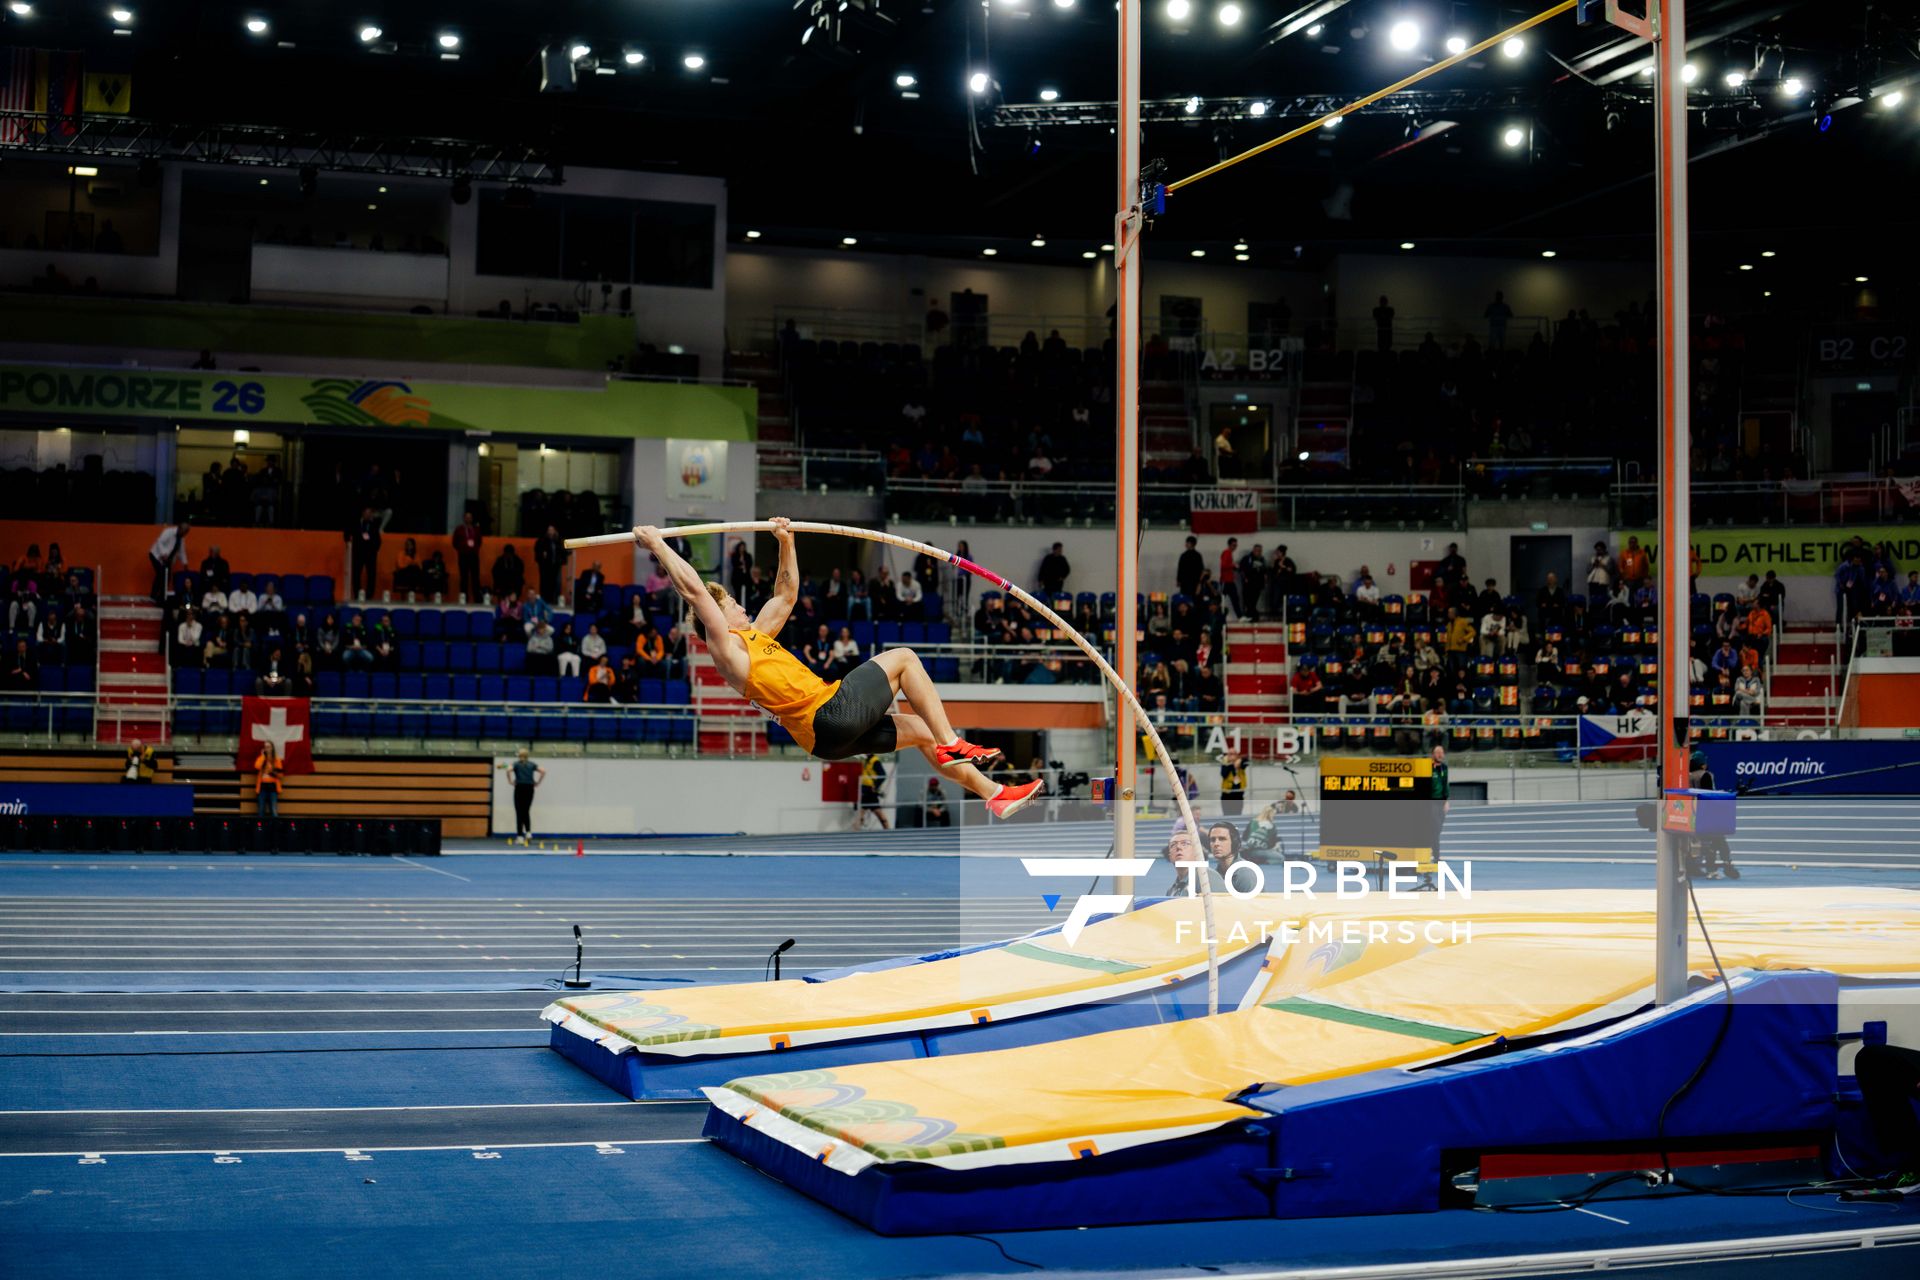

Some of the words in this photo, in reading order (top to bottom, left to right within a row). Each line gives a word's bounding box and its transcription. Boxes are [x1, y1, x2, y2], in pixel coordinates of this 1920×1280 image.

[1200, 348, 1236, 371] A2
[1819, 337, 1855, 360] B2
[1869, 336, 1907, 360] C2
[1248, 348, 1284, 372] B2
[0, 372, 202, 411] POMORZE
[213, 380, 266, 414] 26
[1644, 543, 1728, 563] WLD
[1617, 717, 1641, 734] HK
[1204, 726, 1242, 754] A1
[1276, 727, 1311, 754] B1
[1369, 762, 1413, 774] SEIKO
[1736, 757, 1788, 775] sound
[1326, 849, 1360, 858] SEIKO
